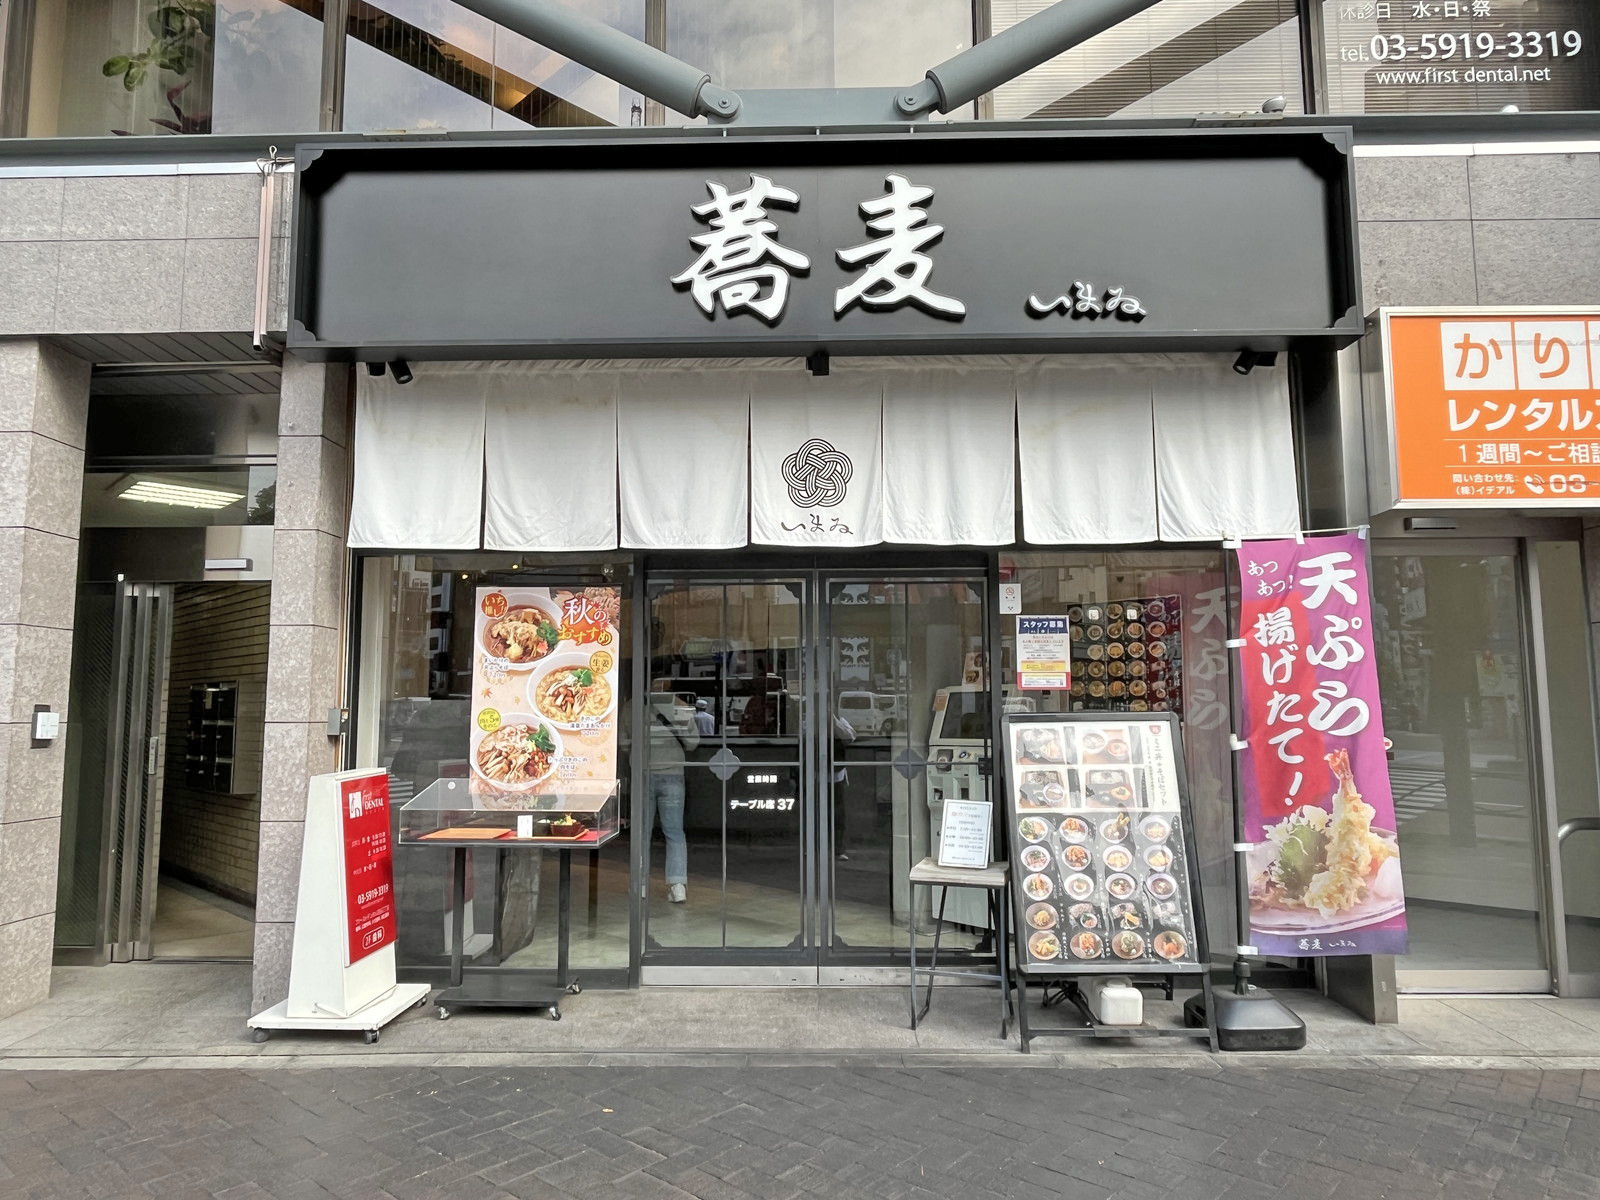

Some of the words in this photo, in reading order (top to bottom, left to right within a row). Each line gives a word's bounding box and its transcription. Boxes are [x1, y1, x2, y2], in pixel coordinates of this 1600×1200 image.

[1340, 2, 1391, 20] 休診日
[1370, 30, 1582, 60] 03-5919-3319
[671, 173, 967, 322] 蕎麦
[563, 597, 607, 625] 秋の
[557, 624, 613, 646] おすすめ
[1298, 551, 1370, 737] 天ぷら
[777, 798, 796, 810] 37
